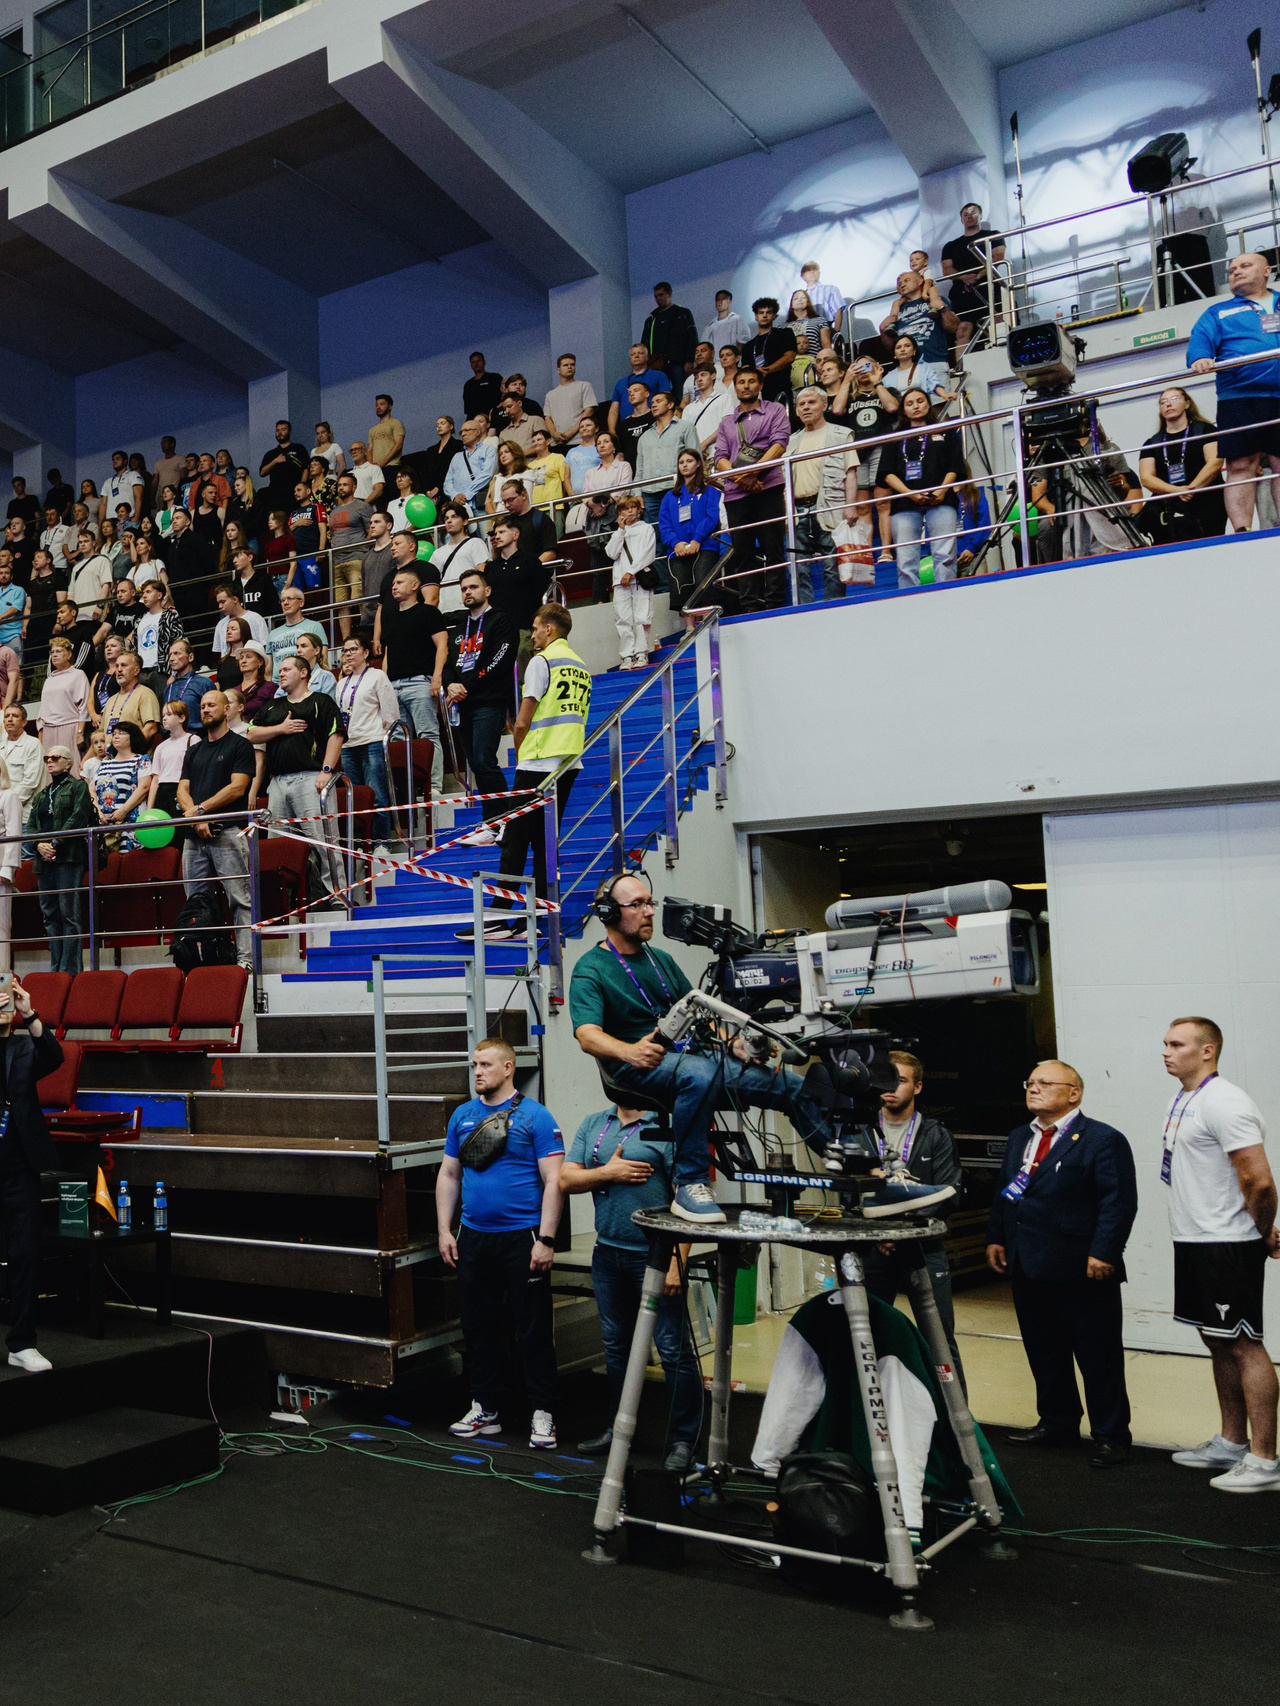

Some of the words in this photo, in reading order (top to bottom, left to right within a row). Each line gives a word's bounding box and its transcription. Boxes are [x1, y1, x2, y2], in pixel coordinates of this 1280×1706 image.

[1140, 332, 1169, 343] ВЫХОД
[560, 668, 591, 683] СТЮАР
[891, 958, 914, 971] 88
[211, 1058, 224, 1079] 4
[103, 1148, 114, 1170] 3
[734, 1172, 833, 1188] EGRIPMENT
